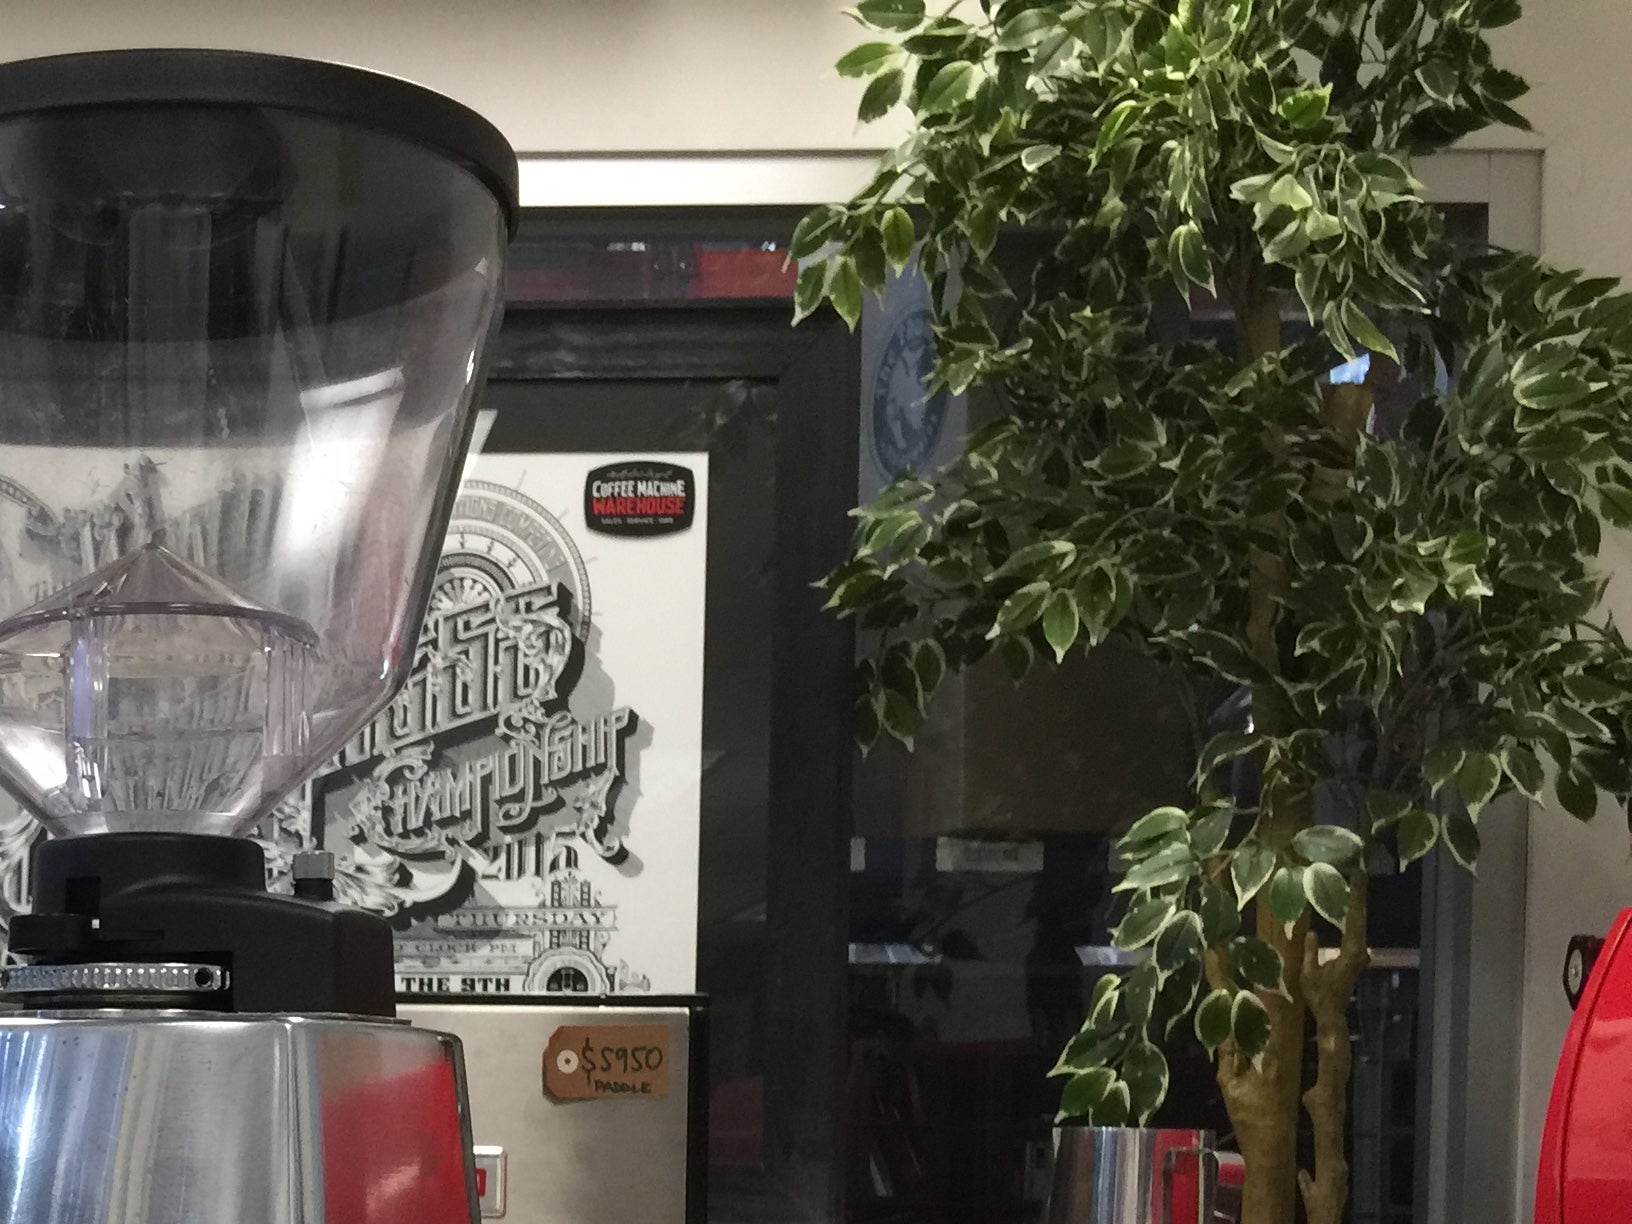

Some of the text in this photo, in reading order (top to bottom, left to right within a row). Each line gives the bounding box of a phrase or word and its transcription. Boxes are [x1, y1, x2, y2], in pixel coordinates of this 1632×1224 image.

[592, 479, 685, 498] COFFEE MACHINE
[592, 496, 684, 515] WAREHOUSE
[358, 707, 631, 850] CHAMPIONSHIP
[455, 912, 603, 927] THURSDAY
[402, 977, 510, 992] THE 9TH
[581, 1037, 663, 1085] $5950
